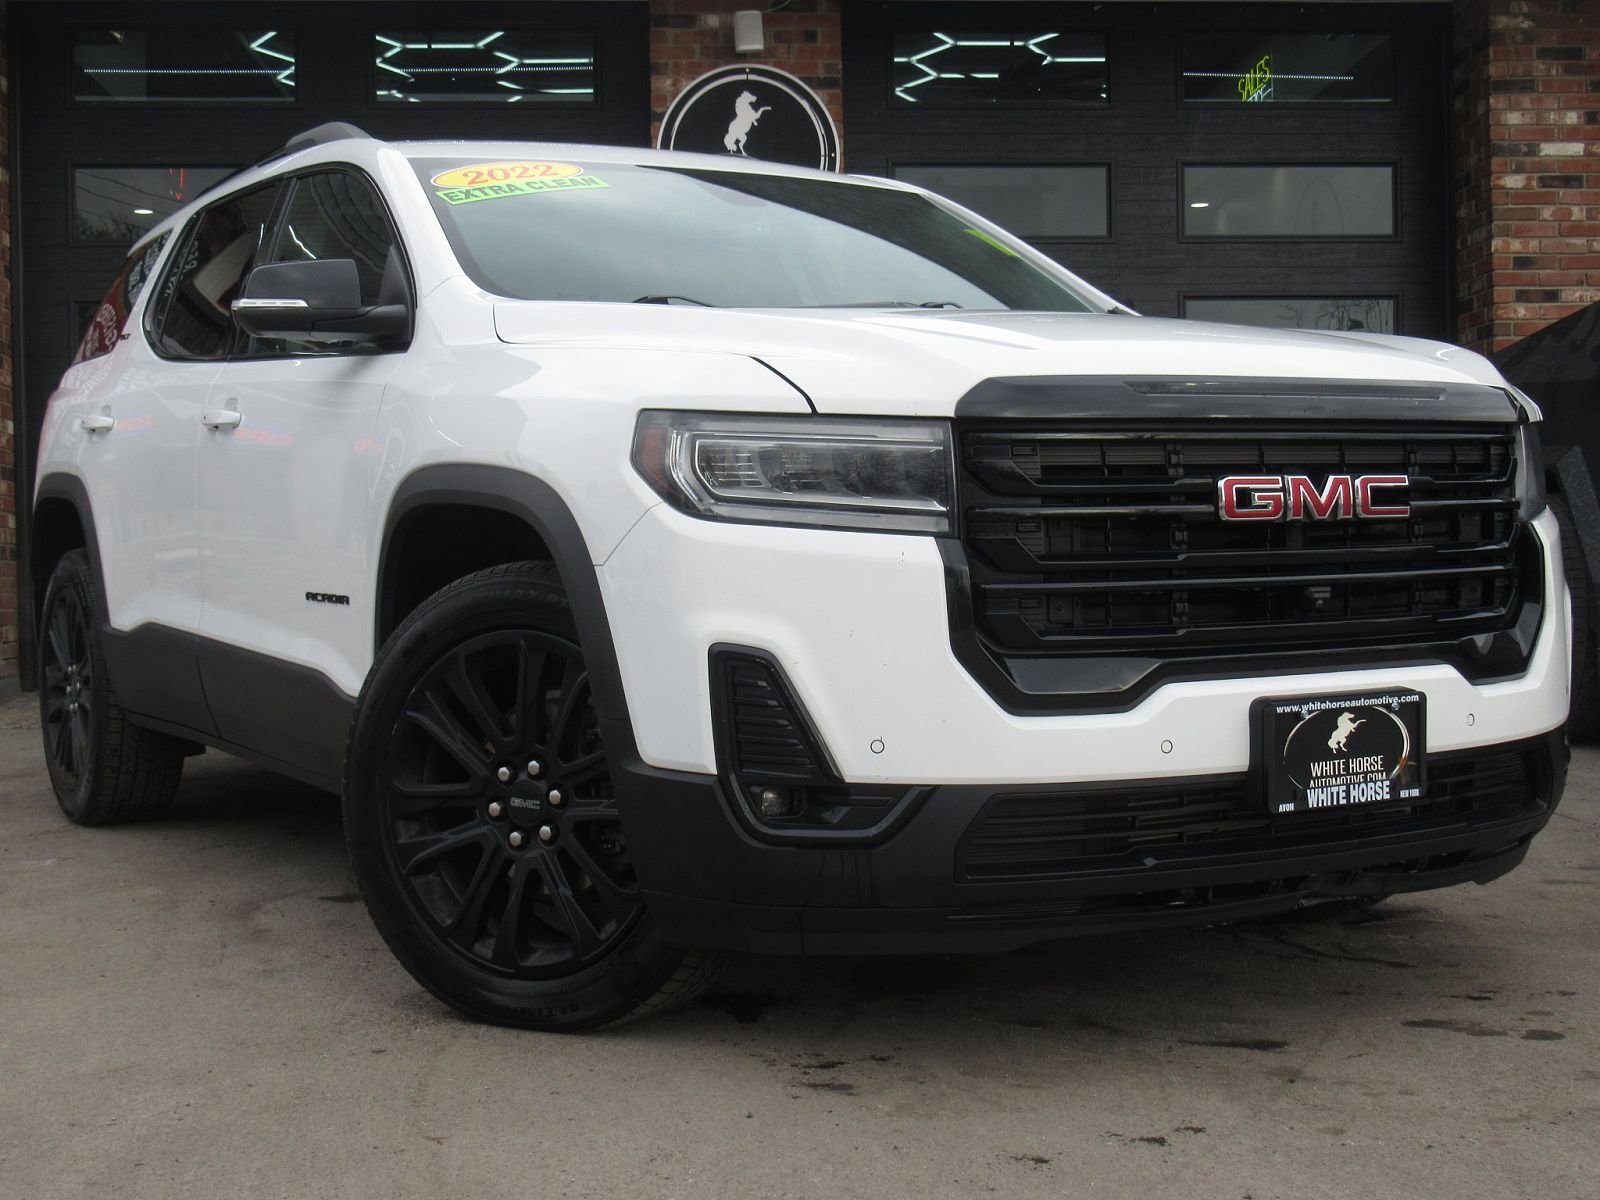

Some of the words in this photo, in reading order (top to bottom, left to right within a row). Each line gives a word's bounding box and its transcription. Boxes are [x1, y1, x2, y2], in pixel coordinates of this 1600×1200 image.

[462, 164, 559, 185] 2022
[443, 183, 520, 203] EXTRA
[525, 176, 599, 190] CLEAN
[1218, 475, 1411, 521] GMC
[1276, 694, 1419, 713] www.whitehorseautomotive.com
[1310, 759, 1346, 777] WHITE
[1349, 755, 1384, 773] HORSE
[510, 797, 540, 810] GMC
[1307, 785, 1347, 808] WHITE
[1350, 780, 1390, 803] HORSE
[1278, 802, 1295, 813] AVON
